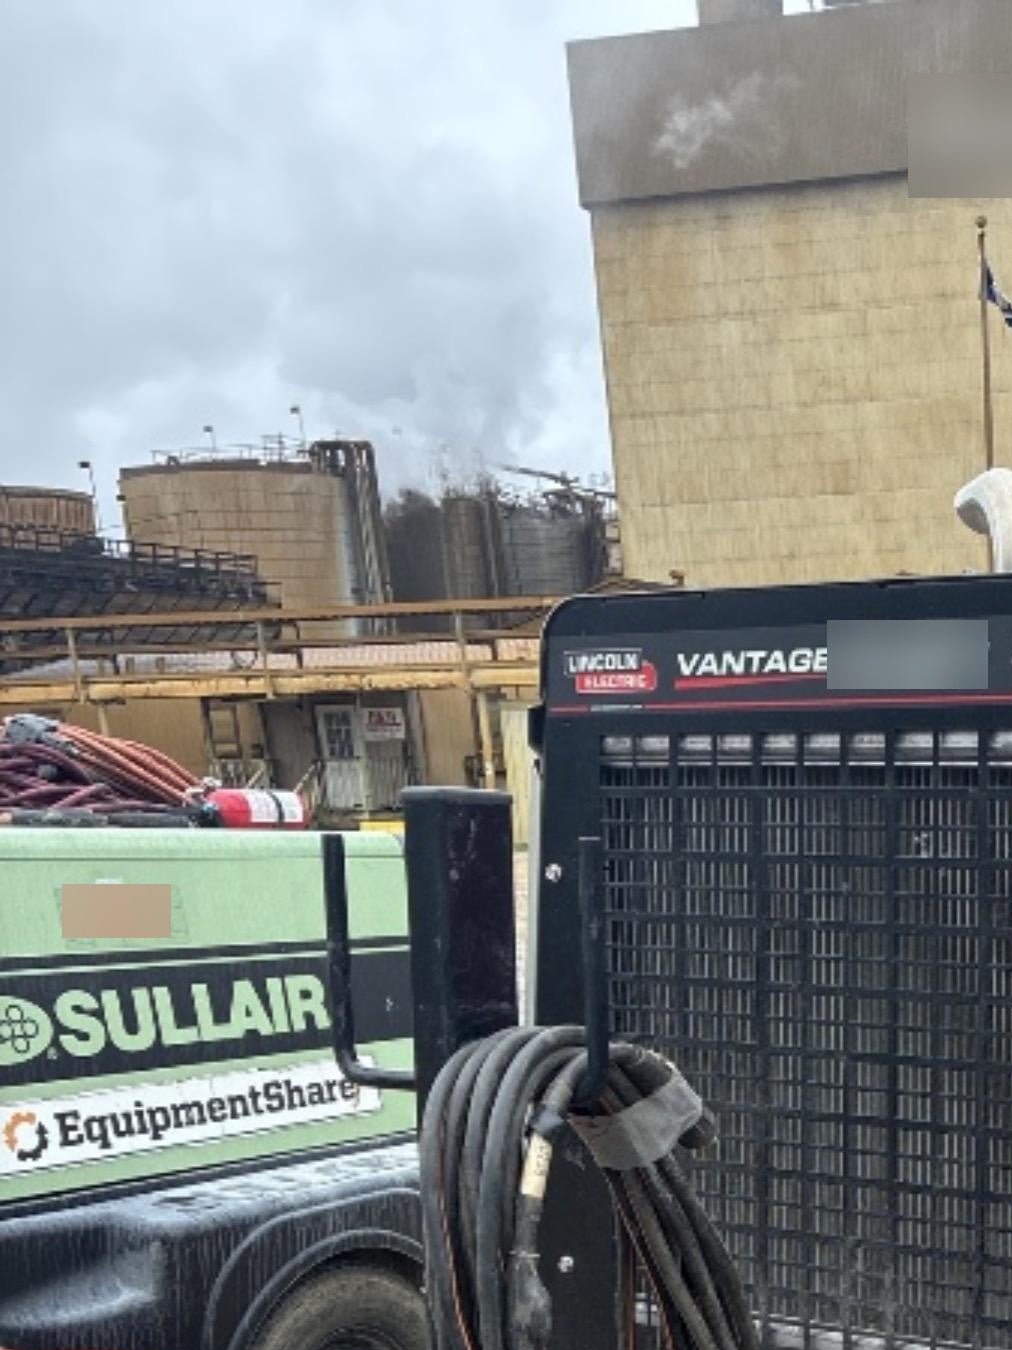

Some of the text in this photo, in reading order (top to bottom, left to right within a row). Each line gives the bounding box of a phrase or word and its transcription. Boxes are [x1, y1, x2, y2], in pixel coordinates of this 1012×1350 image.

[568, 652, 638, 674] LINCOLN
[676, 647, 828, 677] VANTAGE
[583, 673, 648, 689] ELECTRIC
[53, 973, 332, 1058] SULLAIR
[53, 1078, 359, 1148] EquipmentShare
